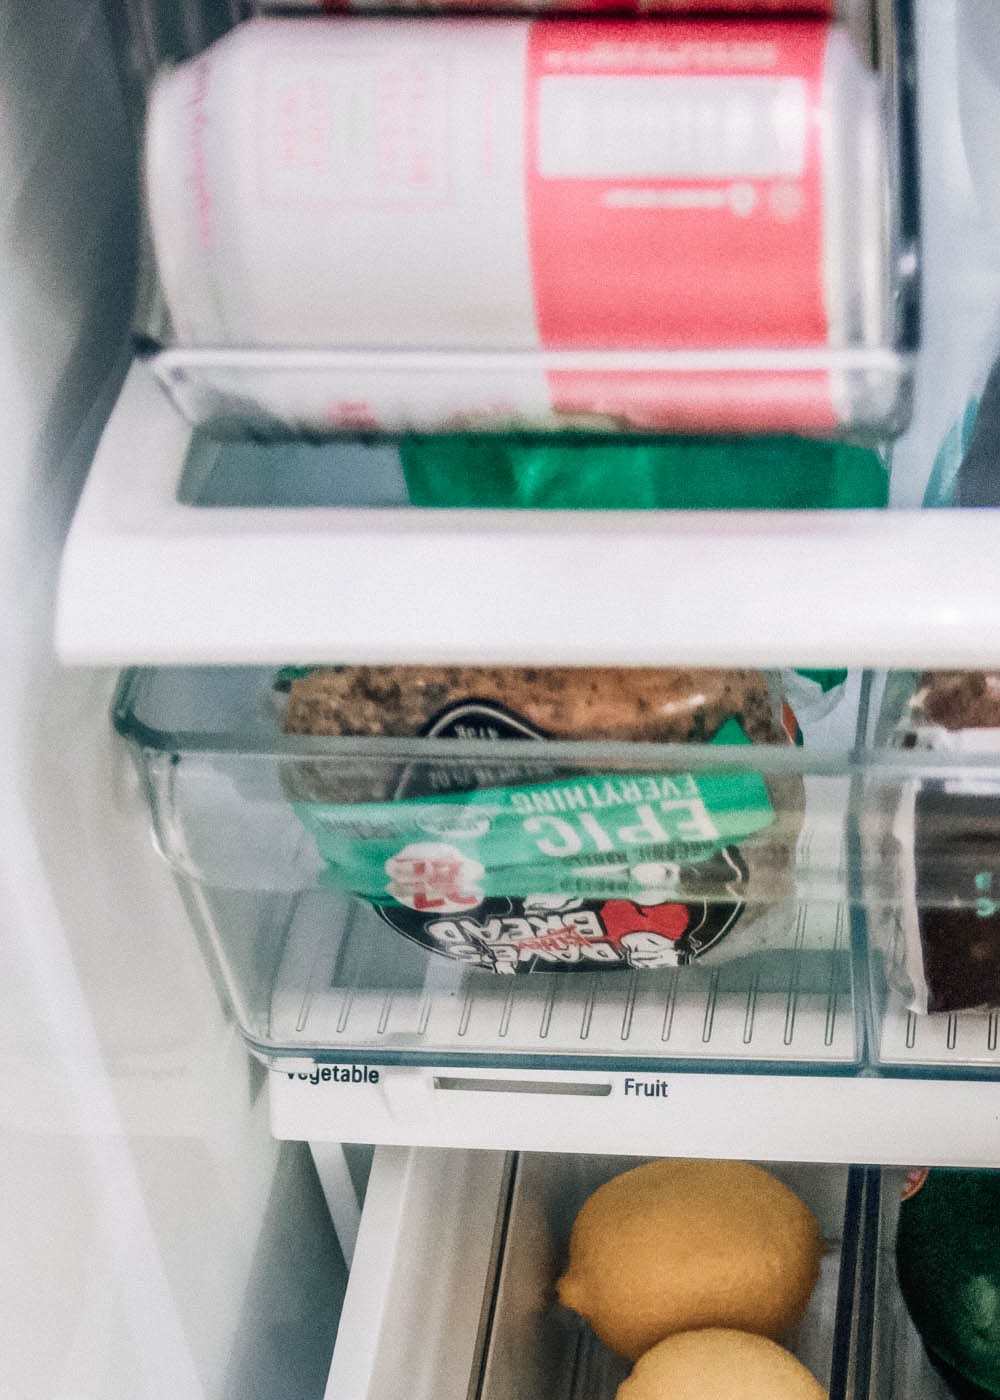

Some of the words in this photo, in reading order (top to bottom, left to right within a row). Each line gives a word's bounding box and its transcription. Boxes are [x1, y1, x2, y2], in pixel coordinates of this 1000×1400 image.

[510, 772, 702, 814] EVERYTHING
[523, 797, 721, 857] EPIC
[424, 909, 606, 943] BREAD
[447, 941, 627, 965] DAVE'S
[624, 1078, 669, 1098] Fruit
